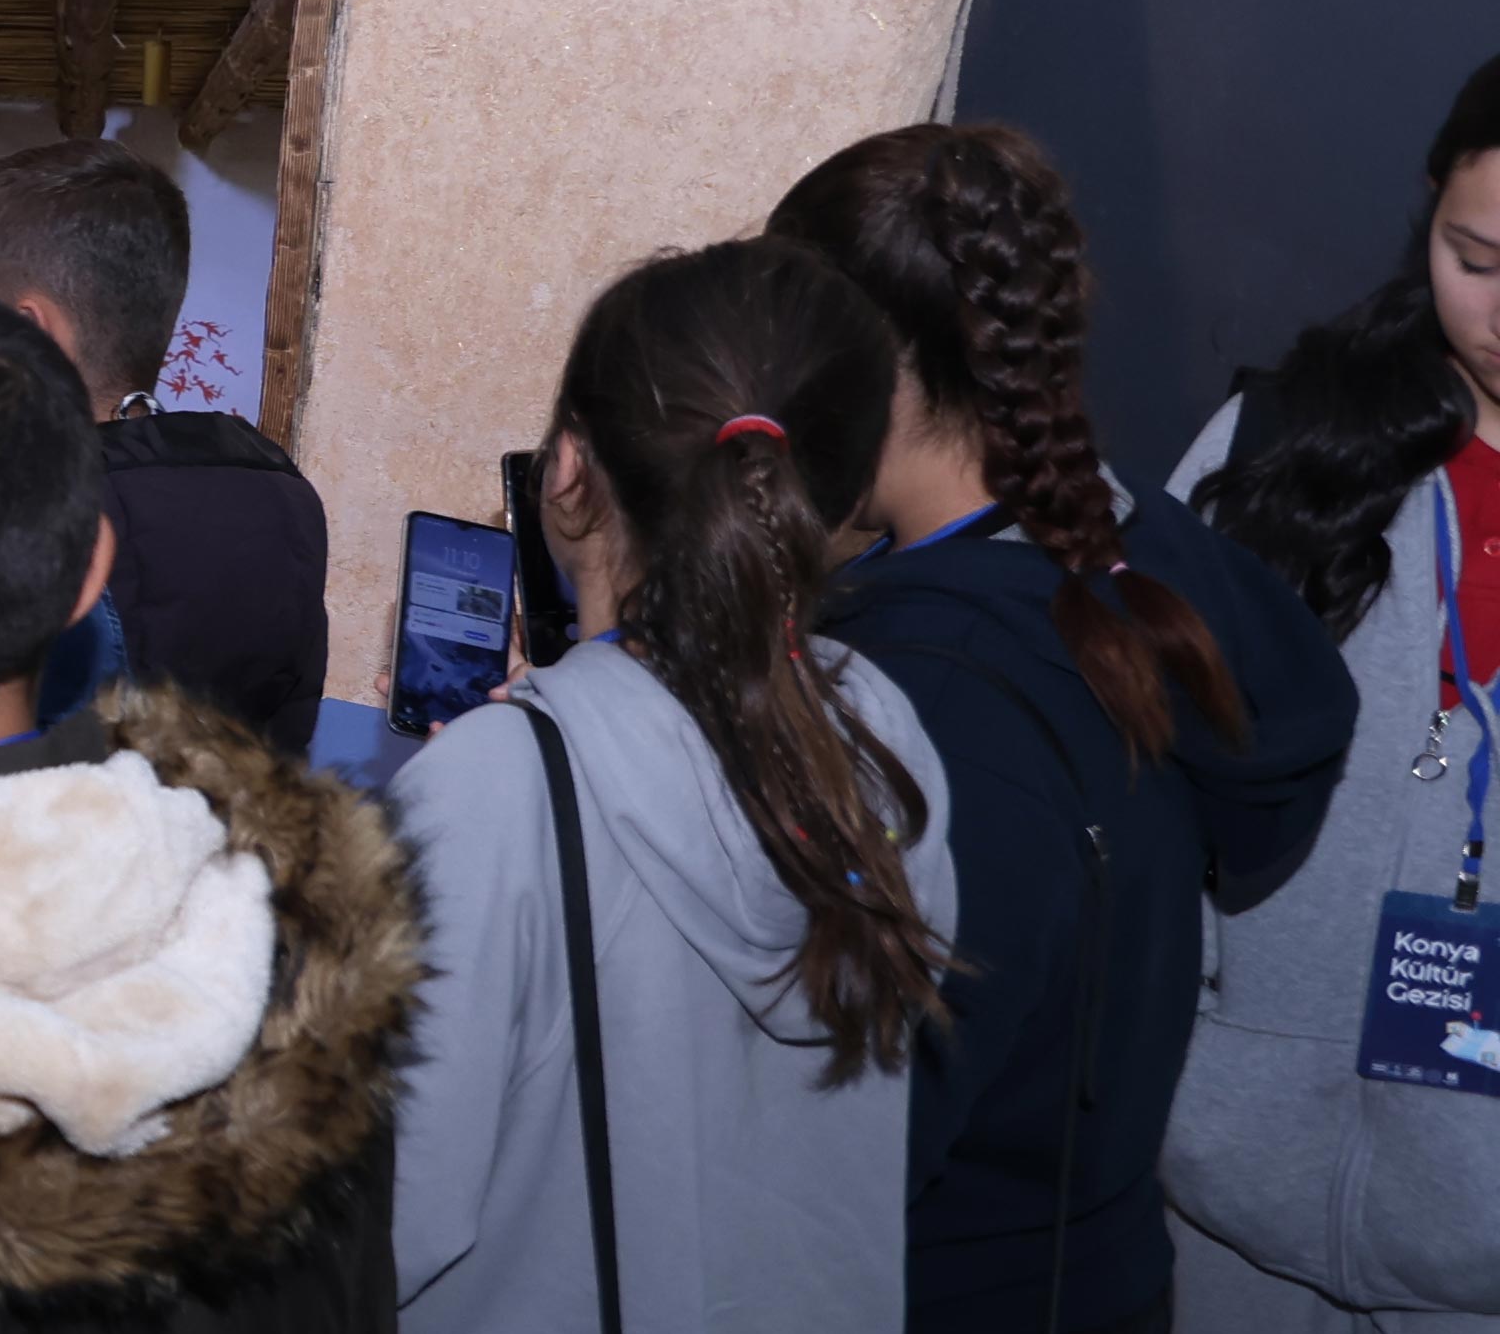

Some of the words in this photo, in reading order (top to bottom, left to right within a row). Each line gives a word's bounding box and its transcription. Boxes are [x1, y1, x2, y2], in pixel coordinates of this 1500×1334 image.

[1394, 931, 1480, 963] Konya
[1390, 957, 1473, 987] Kültür
[1386, 983, 1472, 1012] Gezisi
